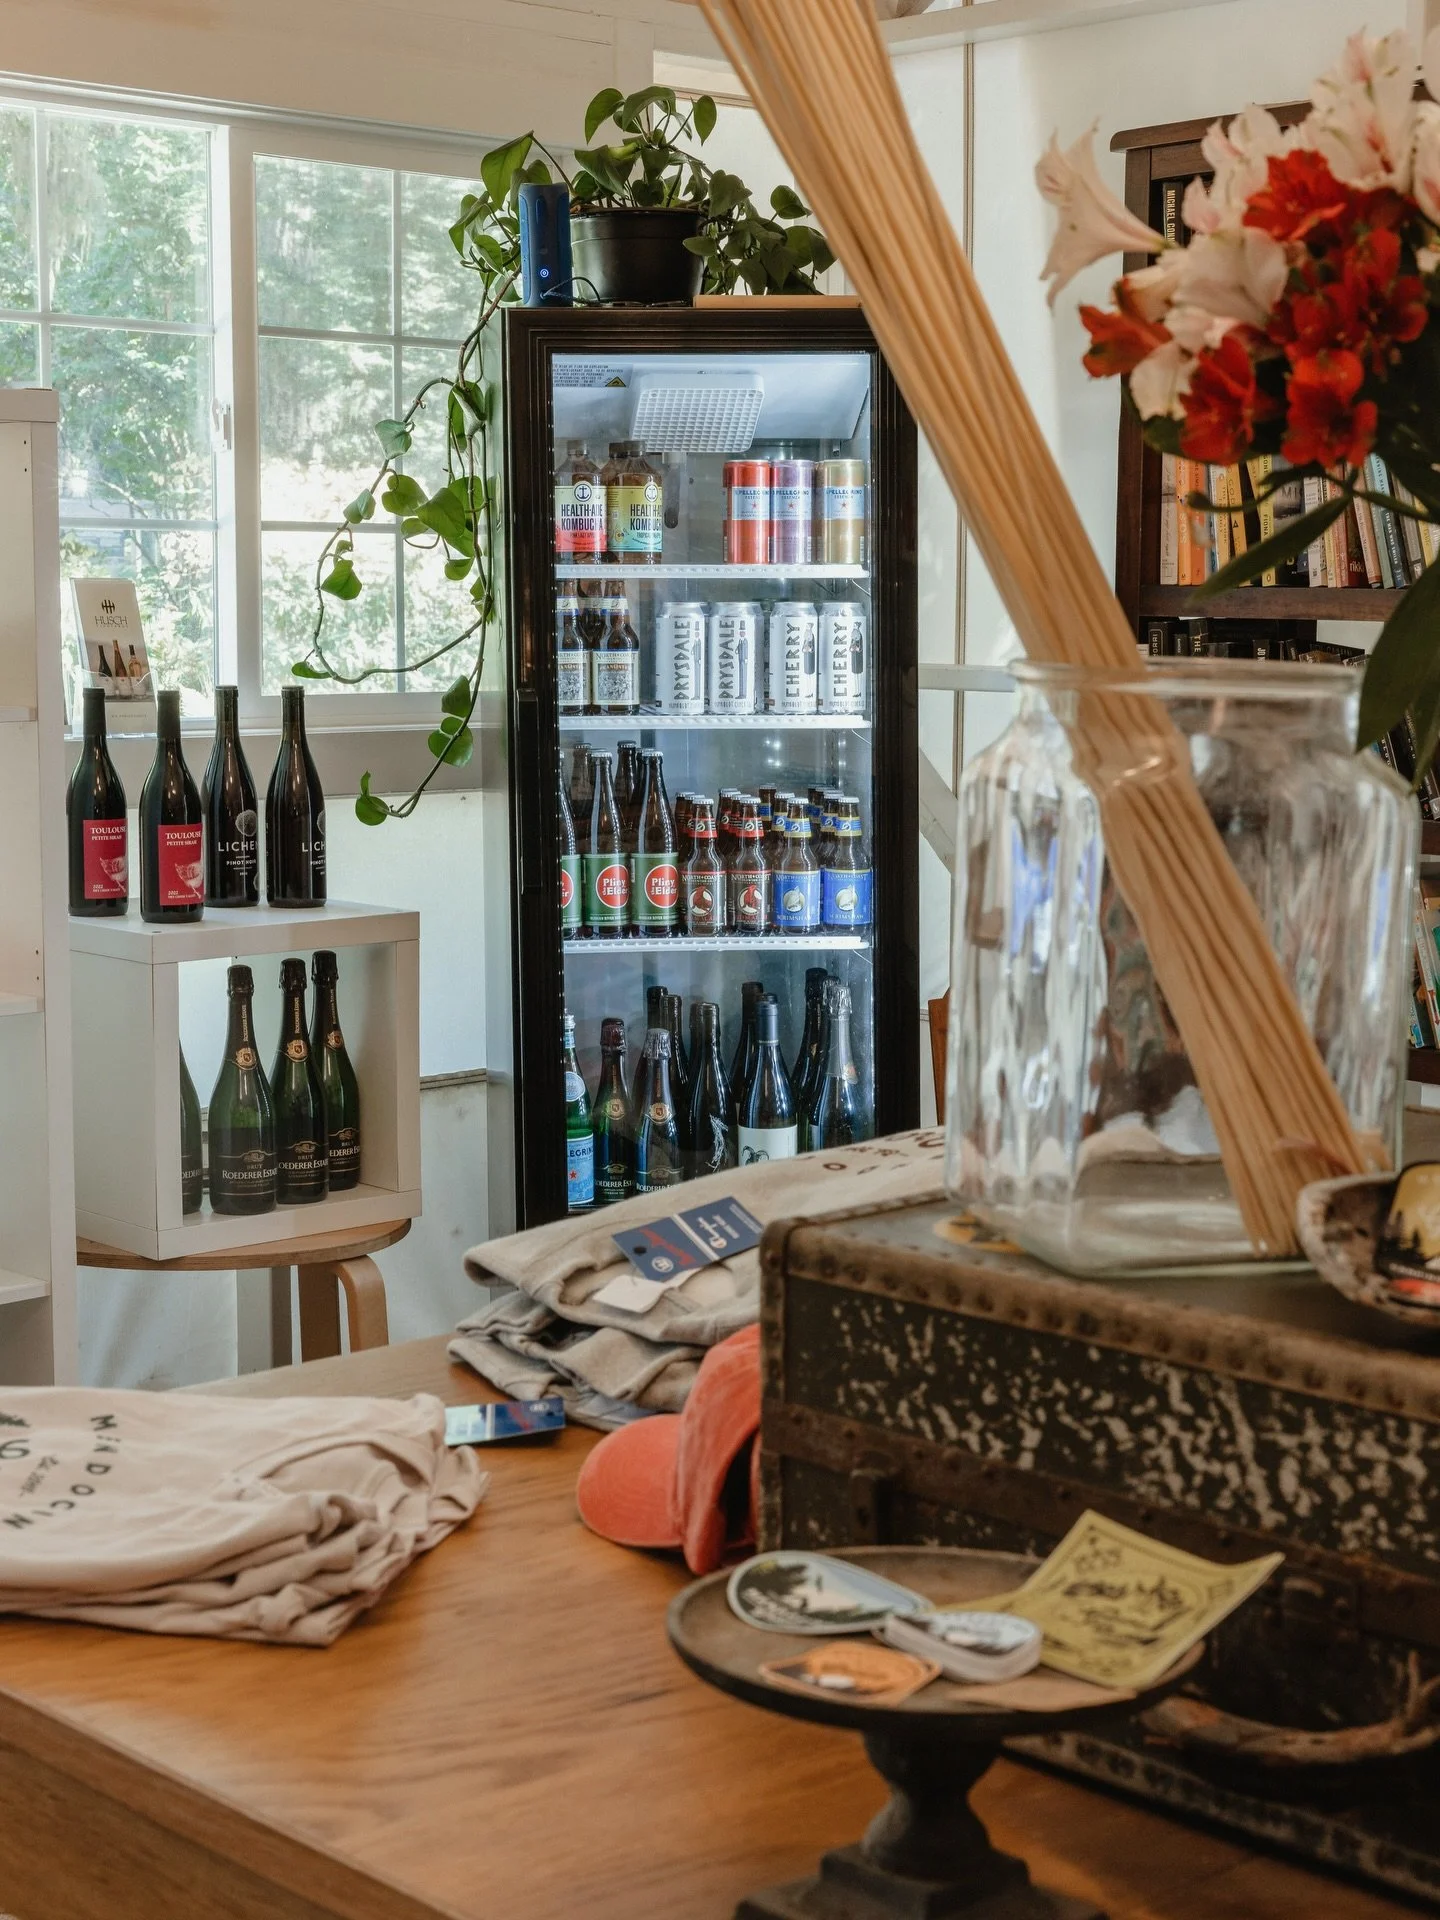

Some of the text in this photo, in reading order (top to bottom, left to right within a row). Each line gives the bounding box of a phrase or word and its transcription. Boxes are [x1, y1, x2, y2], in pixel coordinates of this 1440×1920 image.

[1166, 189, 1176, 221] MICHAEL
[94, 615, 128, 626] HUSCH
[673, 620, 690, 701] DRYSDALE
[718, 619, 735, 699] DRYSDALE
[785, 622, 801, 698] CHERRY
[833, 621, 848, 698] CHERRY
[602, 878, 626, 890] Pliny
[651, 877, 675, 889] Pliny
[606, 887, 629, 896] Elder
[655, 887, 677, 896] Elder
[222, 1169, 262, 1180] ROEDERER
